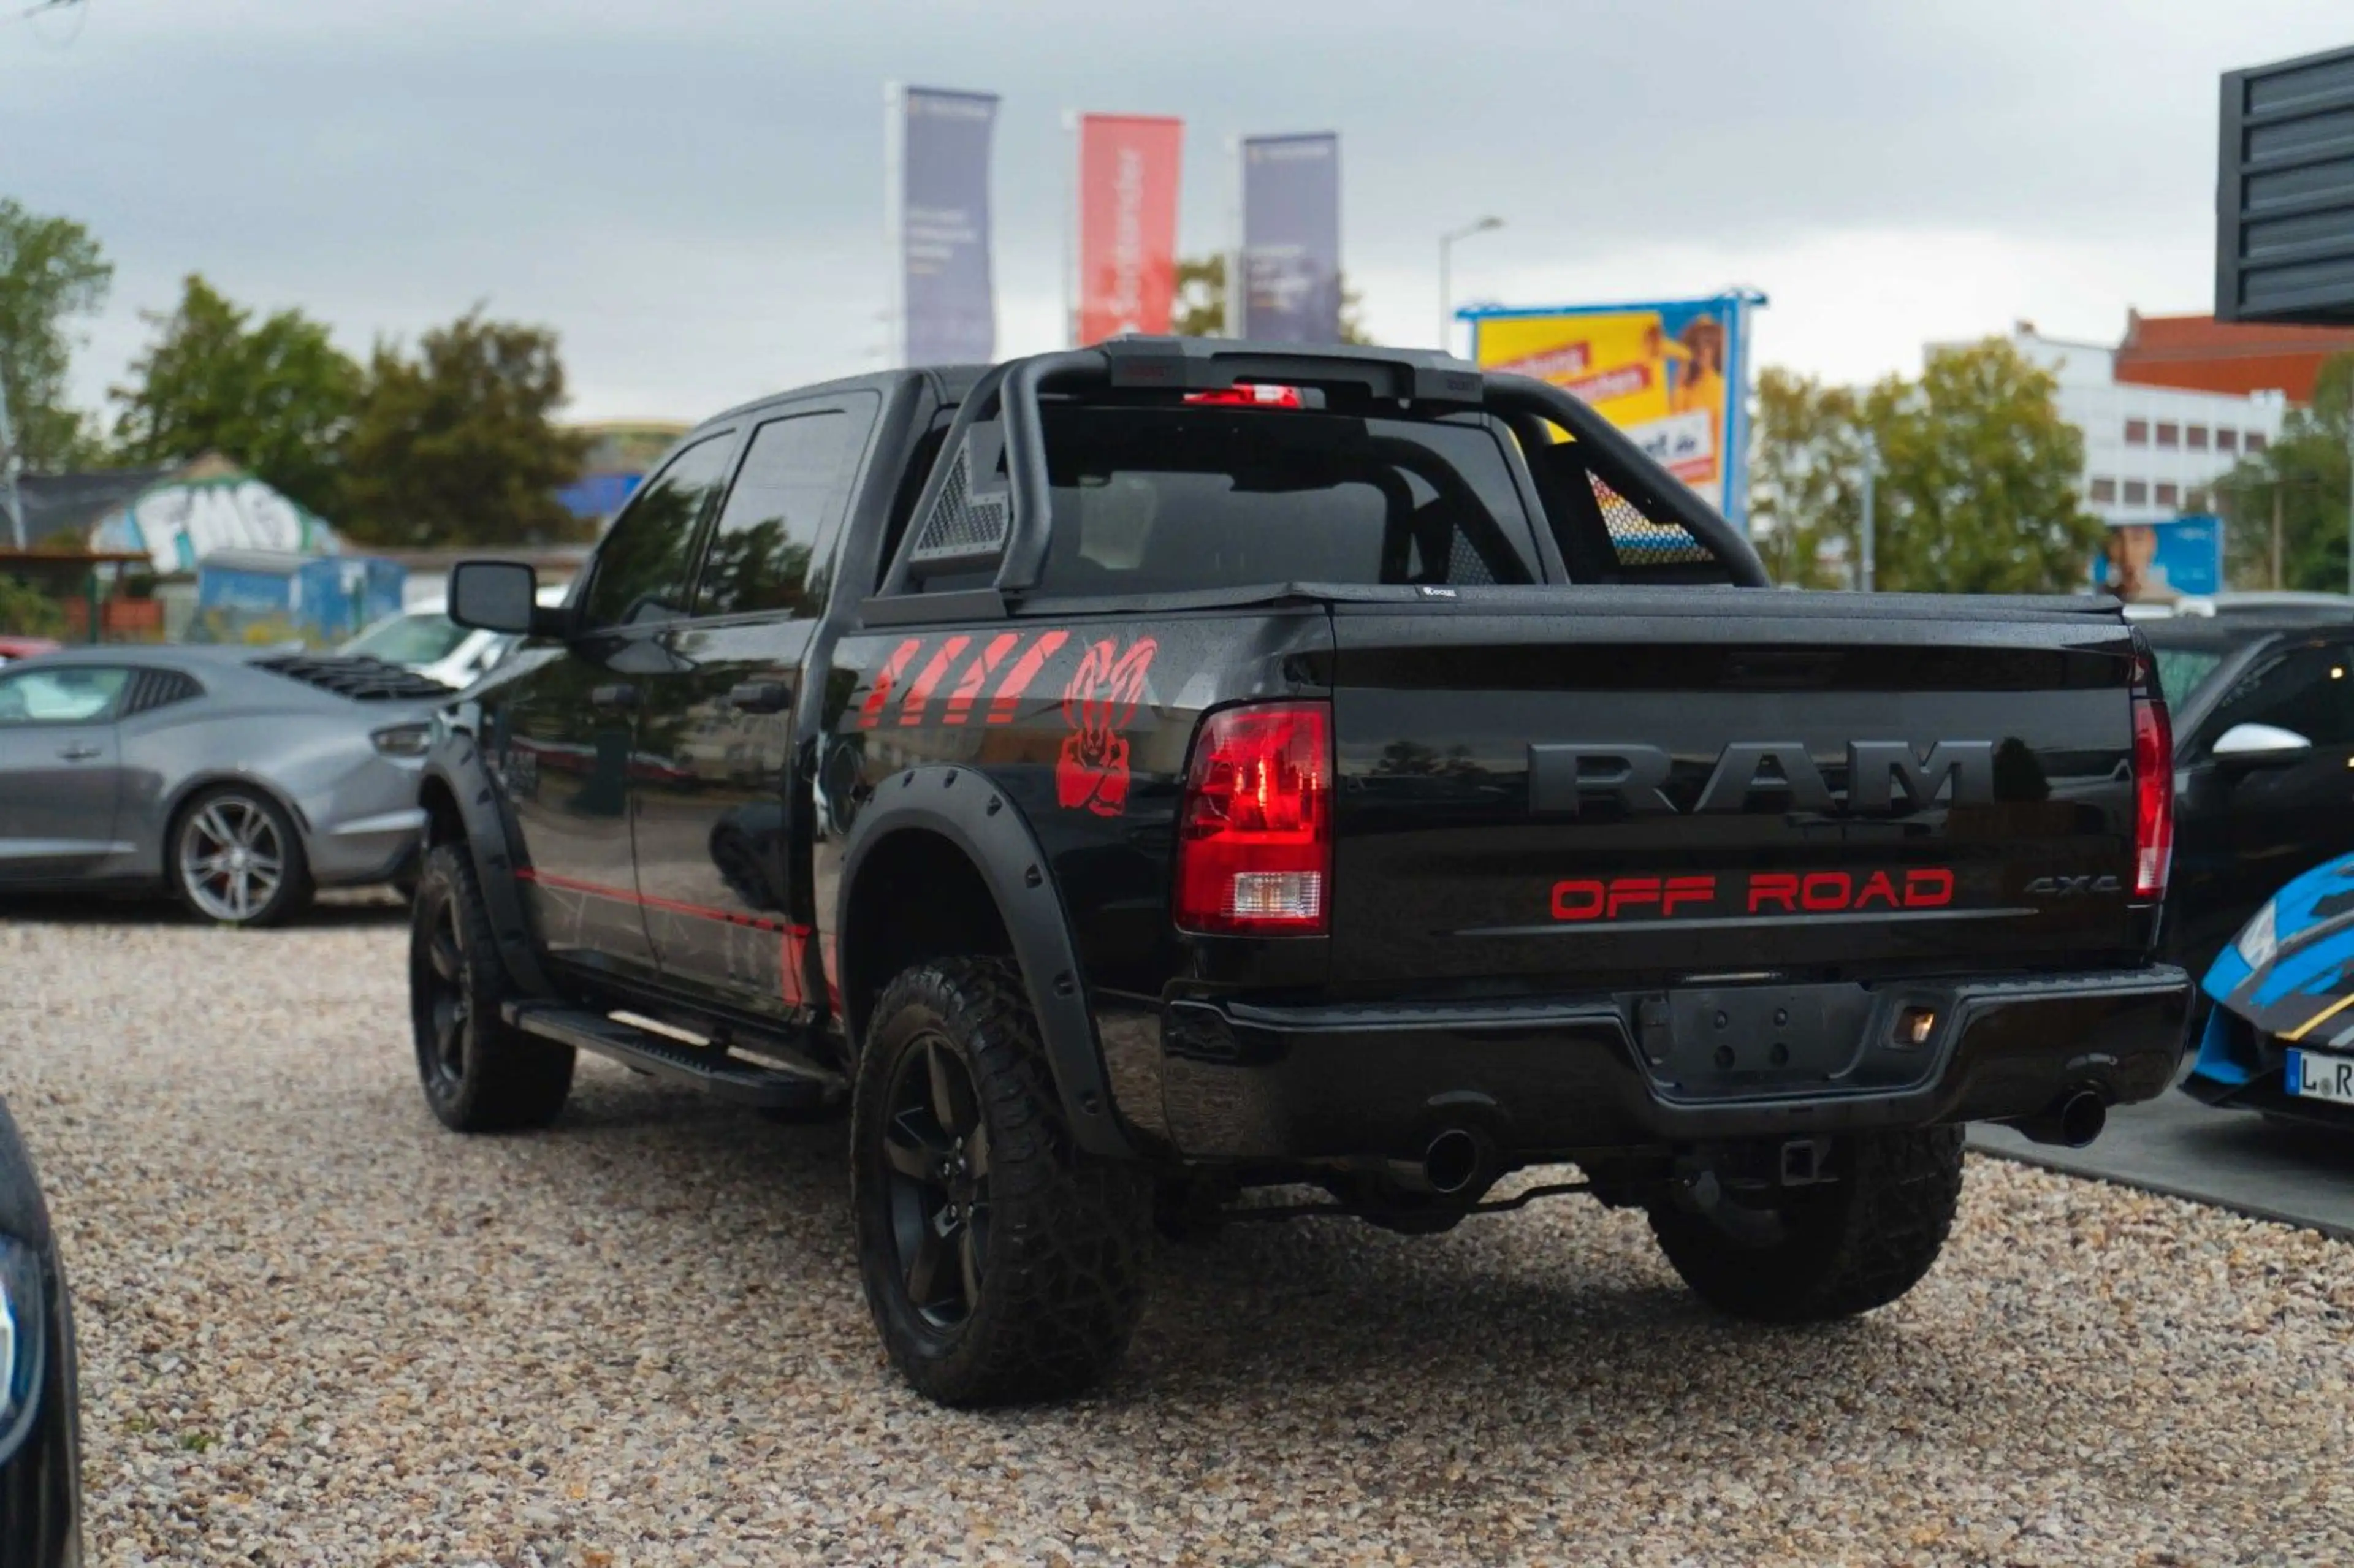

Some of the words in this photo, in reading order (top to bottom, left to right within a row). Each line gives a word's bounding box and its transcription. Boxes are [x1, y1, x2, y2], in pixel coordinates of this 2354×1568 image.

[1528, 740, 1995, 812] RAM
[1552, 876, 1715, 919] OFF
[1748, 869, 1954, 911] ROAD
